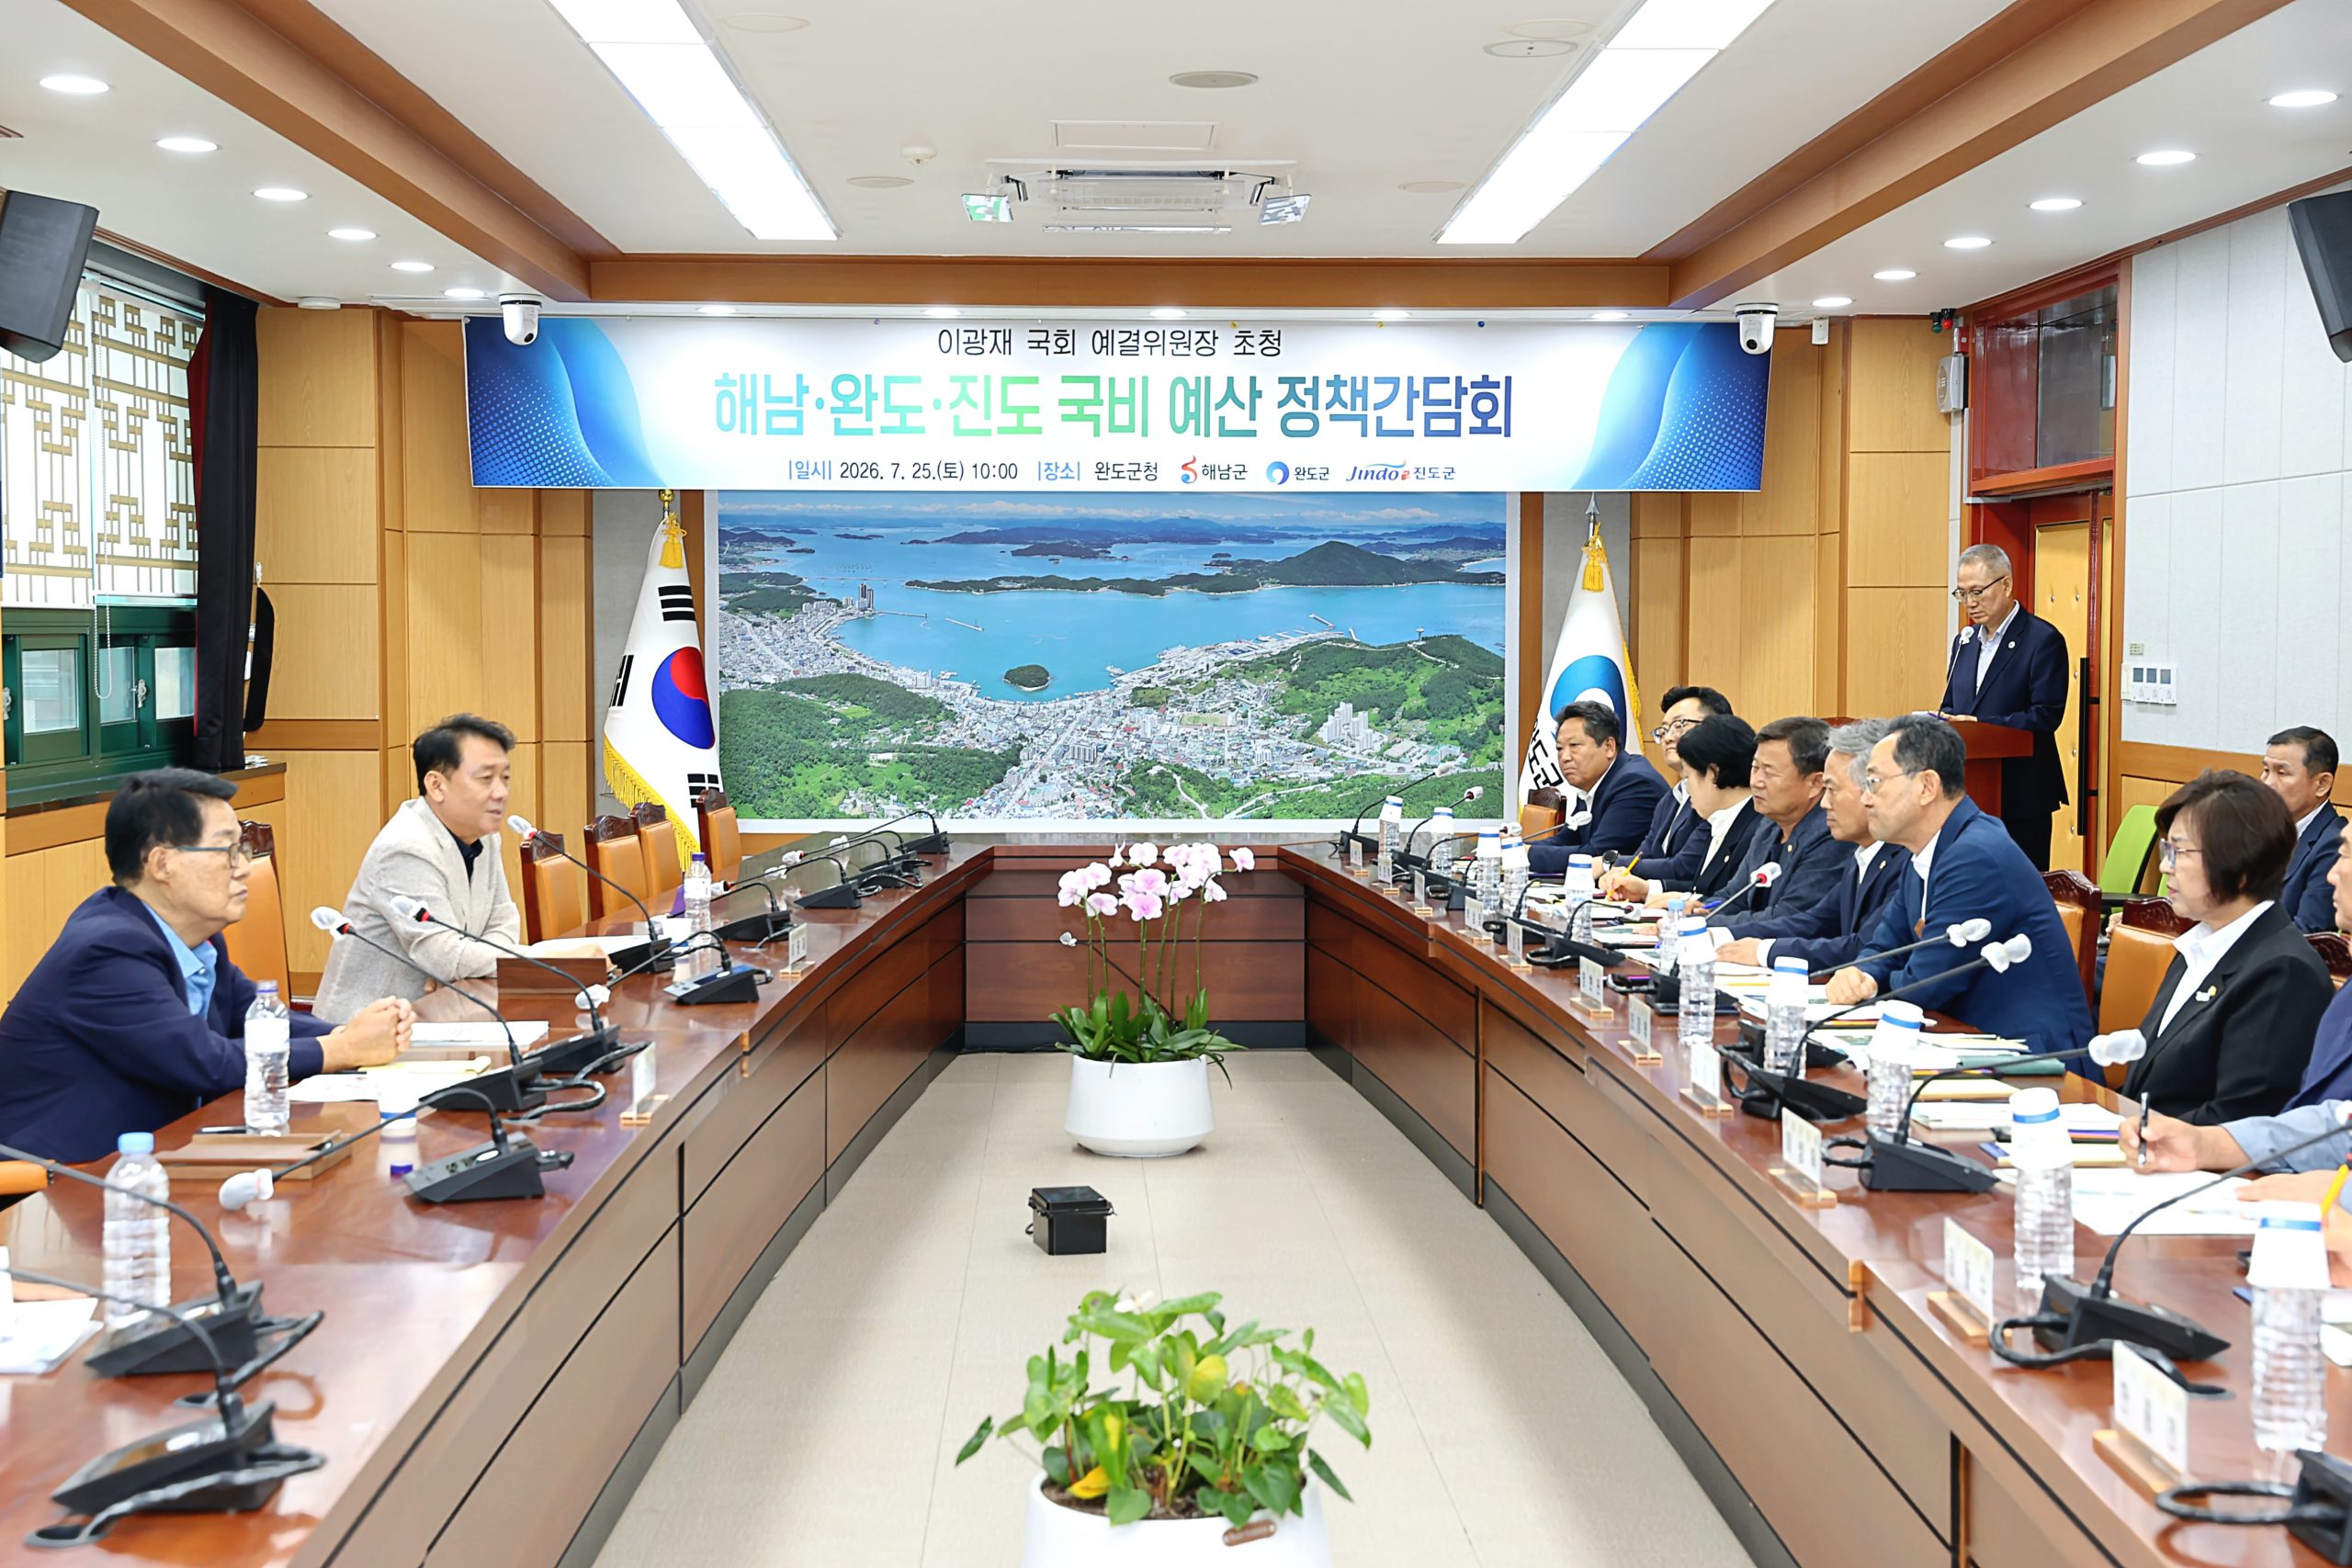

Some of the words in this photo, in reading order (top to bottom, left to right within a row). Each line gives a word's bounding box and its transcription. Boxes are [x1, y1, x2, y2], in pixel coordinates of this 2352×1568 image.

[937, 328, 1013, 356] 이광재
[1026, 328, 1077, 356] 국회
[1091, 328, 1219, 357] 예결위원장
[1232, 329, 1283, 357] 초청
[714, 372, 1044, 437] 해남·완도·진도
[1057, 375, 1149, 438] 국비
[1169, 375, 1263, 438] 예산
[1276, 374, 1513, 438] 정책간담회
[840, 461, 884, 480] 2026.
[890, 462, 905, 480] 7.
[911, 459, 965, 482] 25.(토)
[971, 462, 1019, 480] 10:00
[1093, 461, 1159, 482] 완도군청
[1201, 463, 1249, 481] 해남군
[1294, 466, 1330, 481] 완도군
[1413, 466, 1456, 480] 진도군
